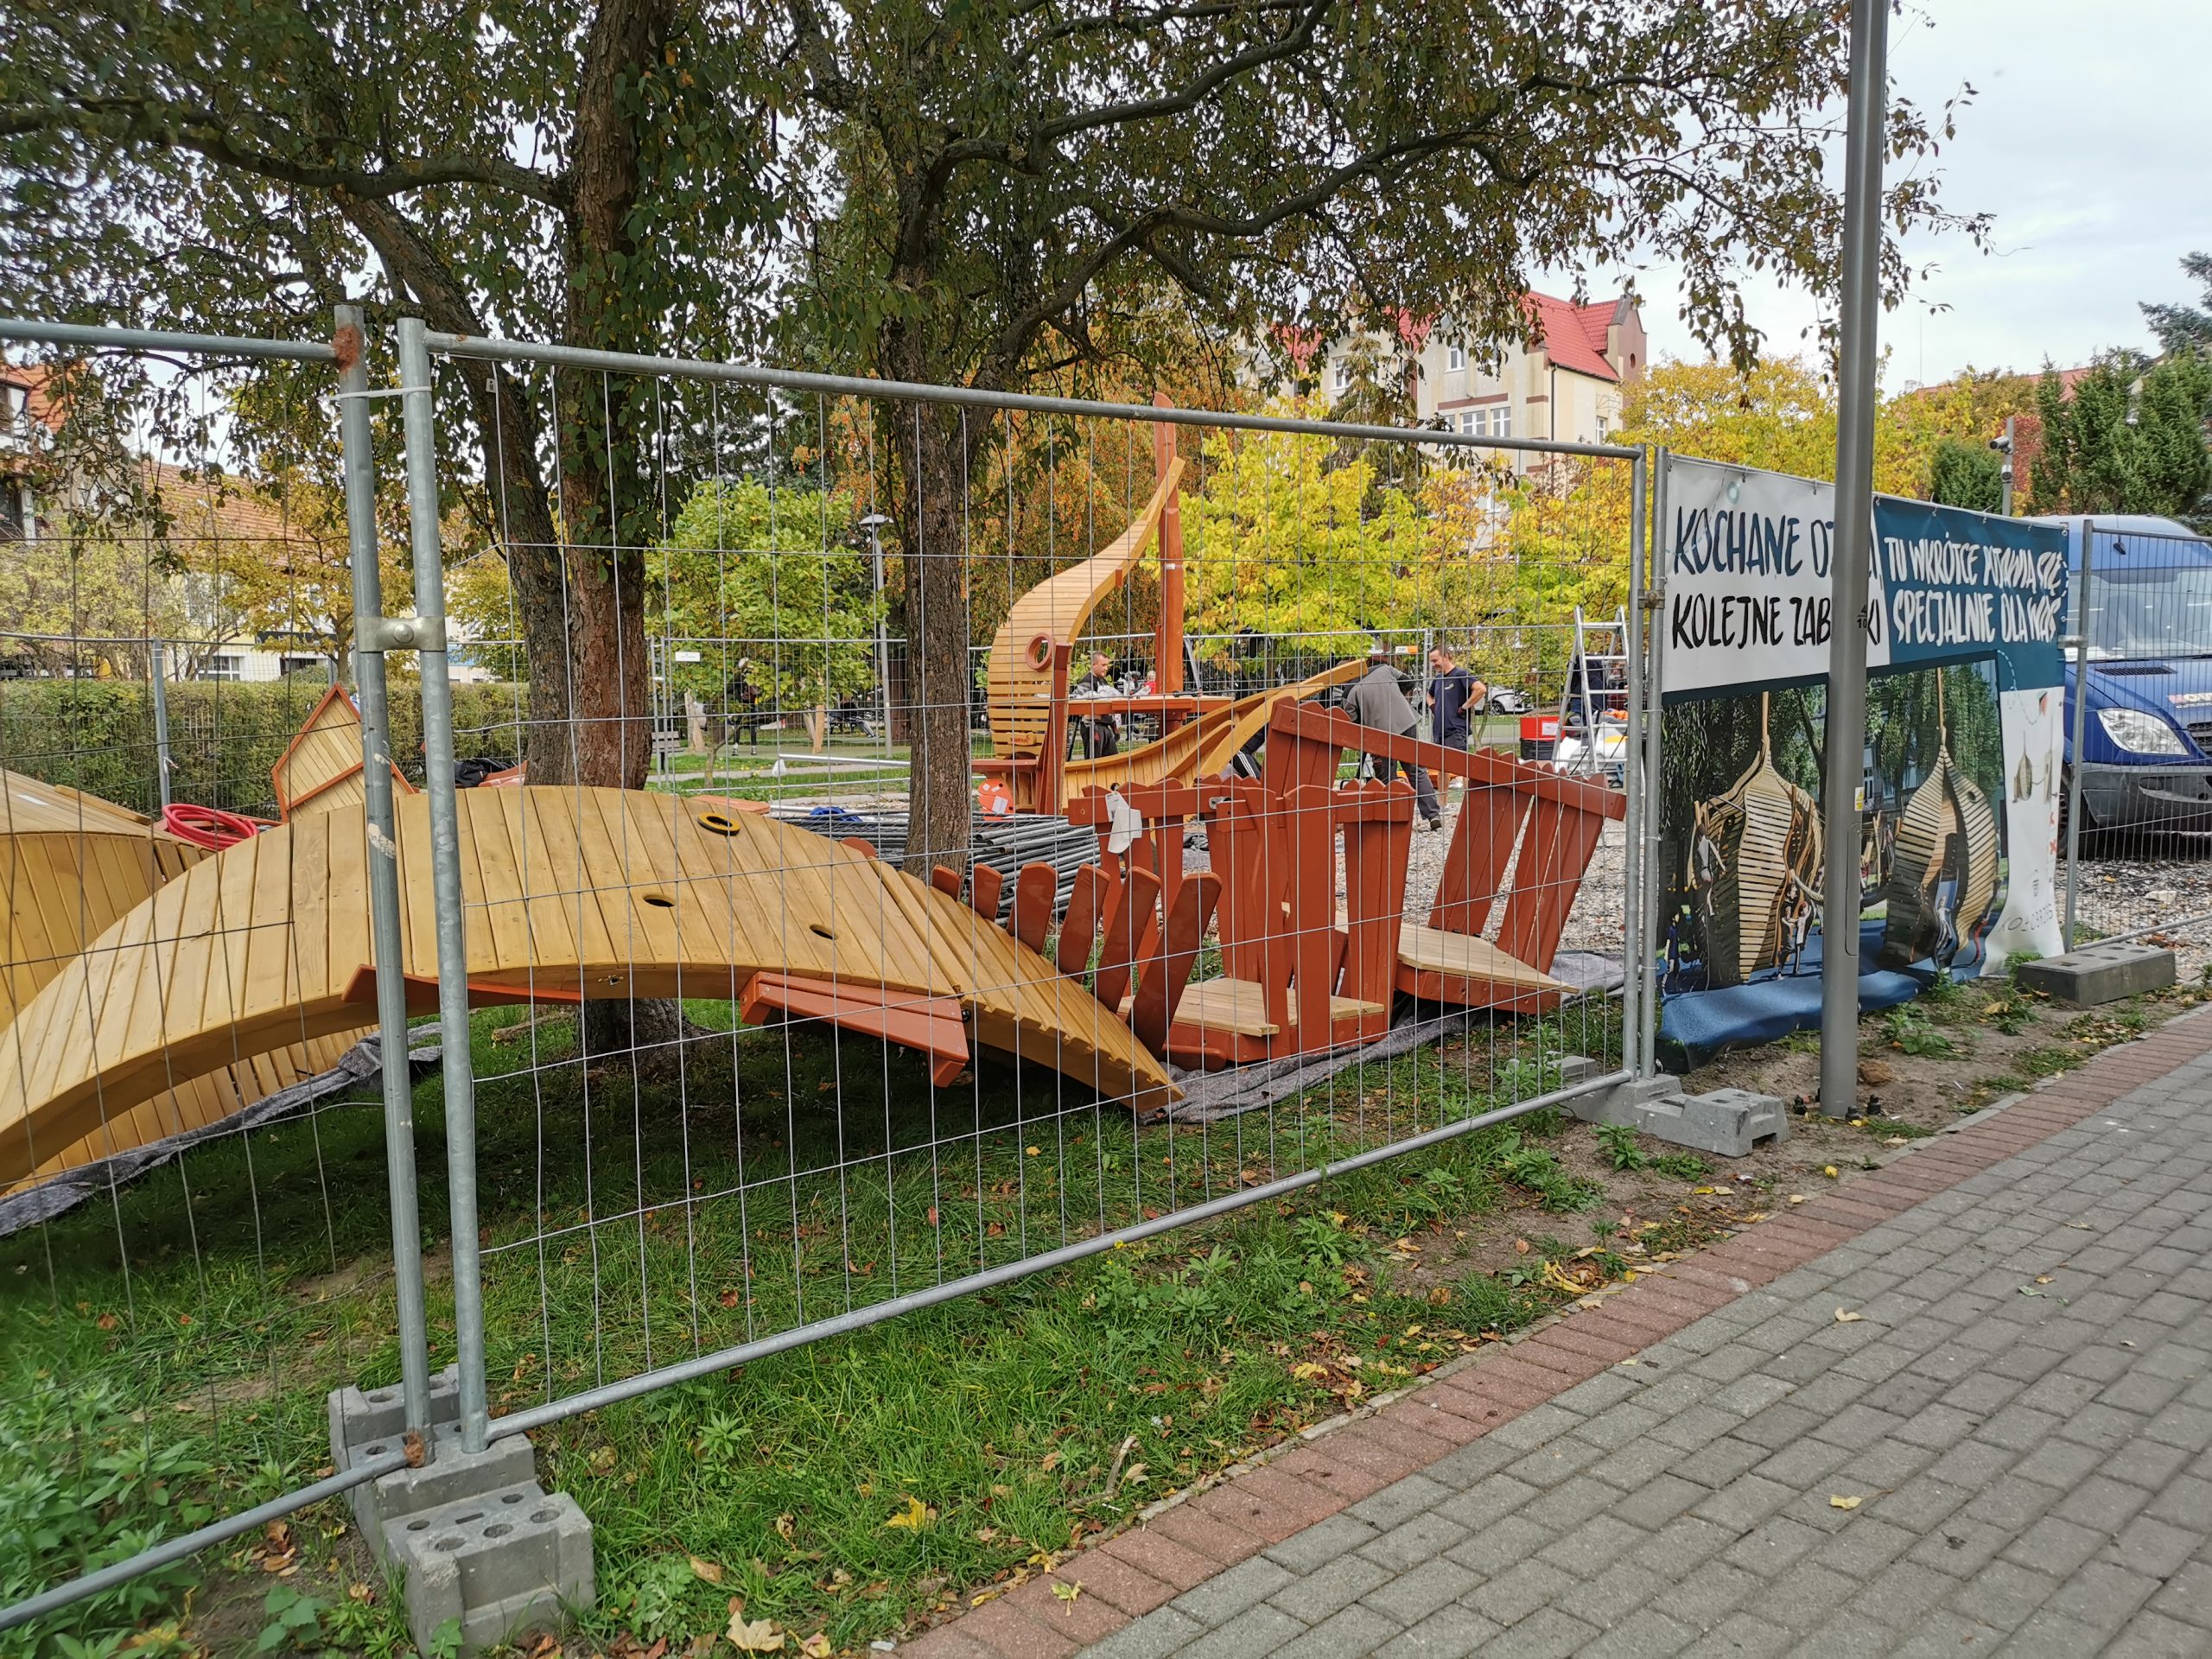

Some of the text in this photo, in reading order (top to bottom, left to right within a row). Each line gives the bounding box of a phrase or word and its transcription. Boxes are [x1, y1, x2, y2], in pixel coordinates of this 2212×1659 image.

[1674, 505, 1802, 576] KOCHANE
[1885, 537, 1907, 582] TU
[1909, 531, 1980, 585] WKRÓTCE
[2037, 551, 2062, 596] SIĘ
[1672, 593, 1880, 649] KOLEJNE ZABKI
[1857, 619, 1867, 628] 10
[1861, 604, 1867, 613] 4
[1893, 588, 1995, 646] SPECJALNIE
[2000, 593, 2028, 643] DLA
